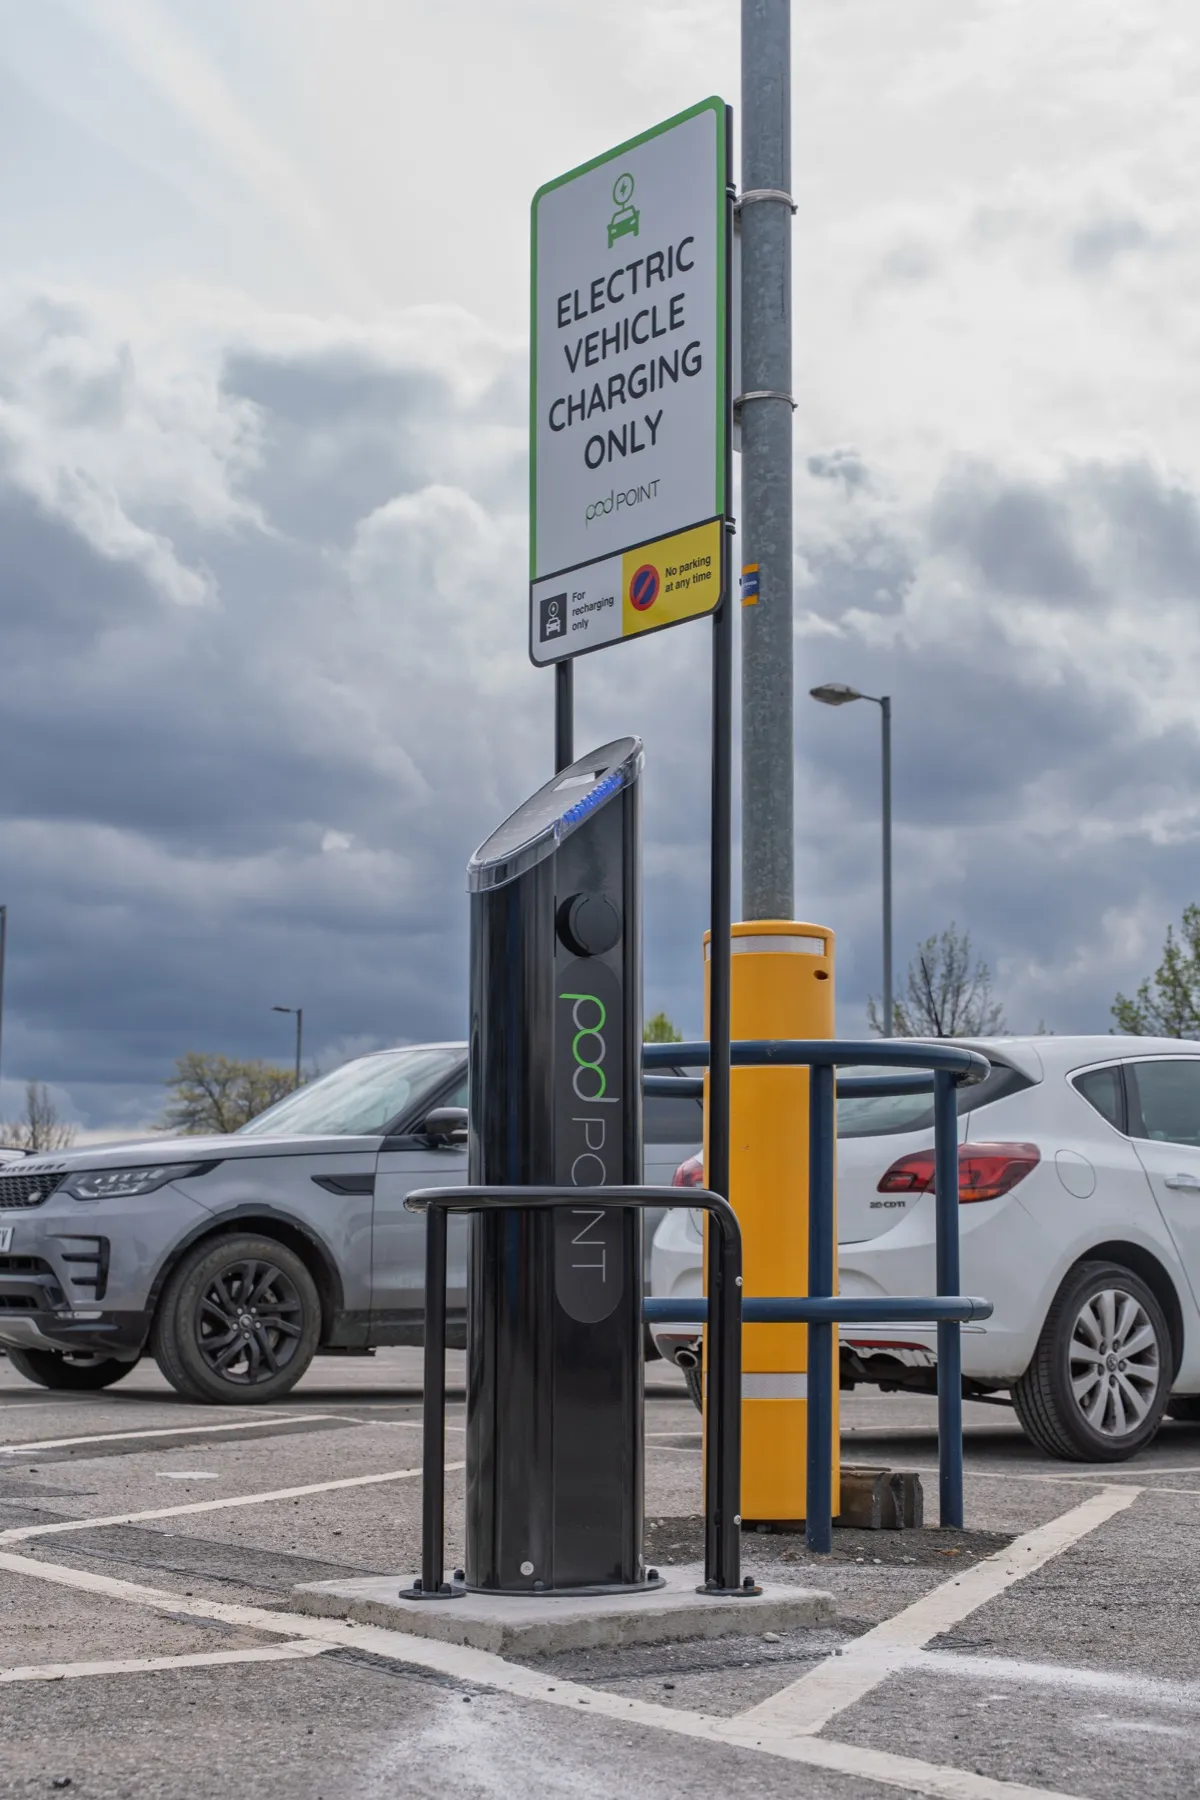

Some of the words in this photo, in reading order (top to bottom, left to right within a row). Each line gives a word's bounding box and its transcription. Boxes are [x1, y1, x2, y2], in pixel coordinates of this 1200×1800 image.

[557, 236, 695, 329] ELECTRIC
[563, 293, 686, 374] VEHICLE
[548, 340, 703, 432] CHARGING
[584, 409, 664, 470] ONLY
[585, 489, 614, 530] pod
[616, 479, 661, 511] POINT
[665, 567, 678, 578] No
[679, 556, 712, 576] parking
[665, 581, 674, 593] at
[675, 577, 691, 589] any
[692, 571, 712, 584] time
[572, 591, 586, 603] For
[572, 596, 615, 617] recharging
[572, 618, 590, 631] only
[558, 993, 620, 1103] pod
[571, 1117, 606, 1284] PONT
